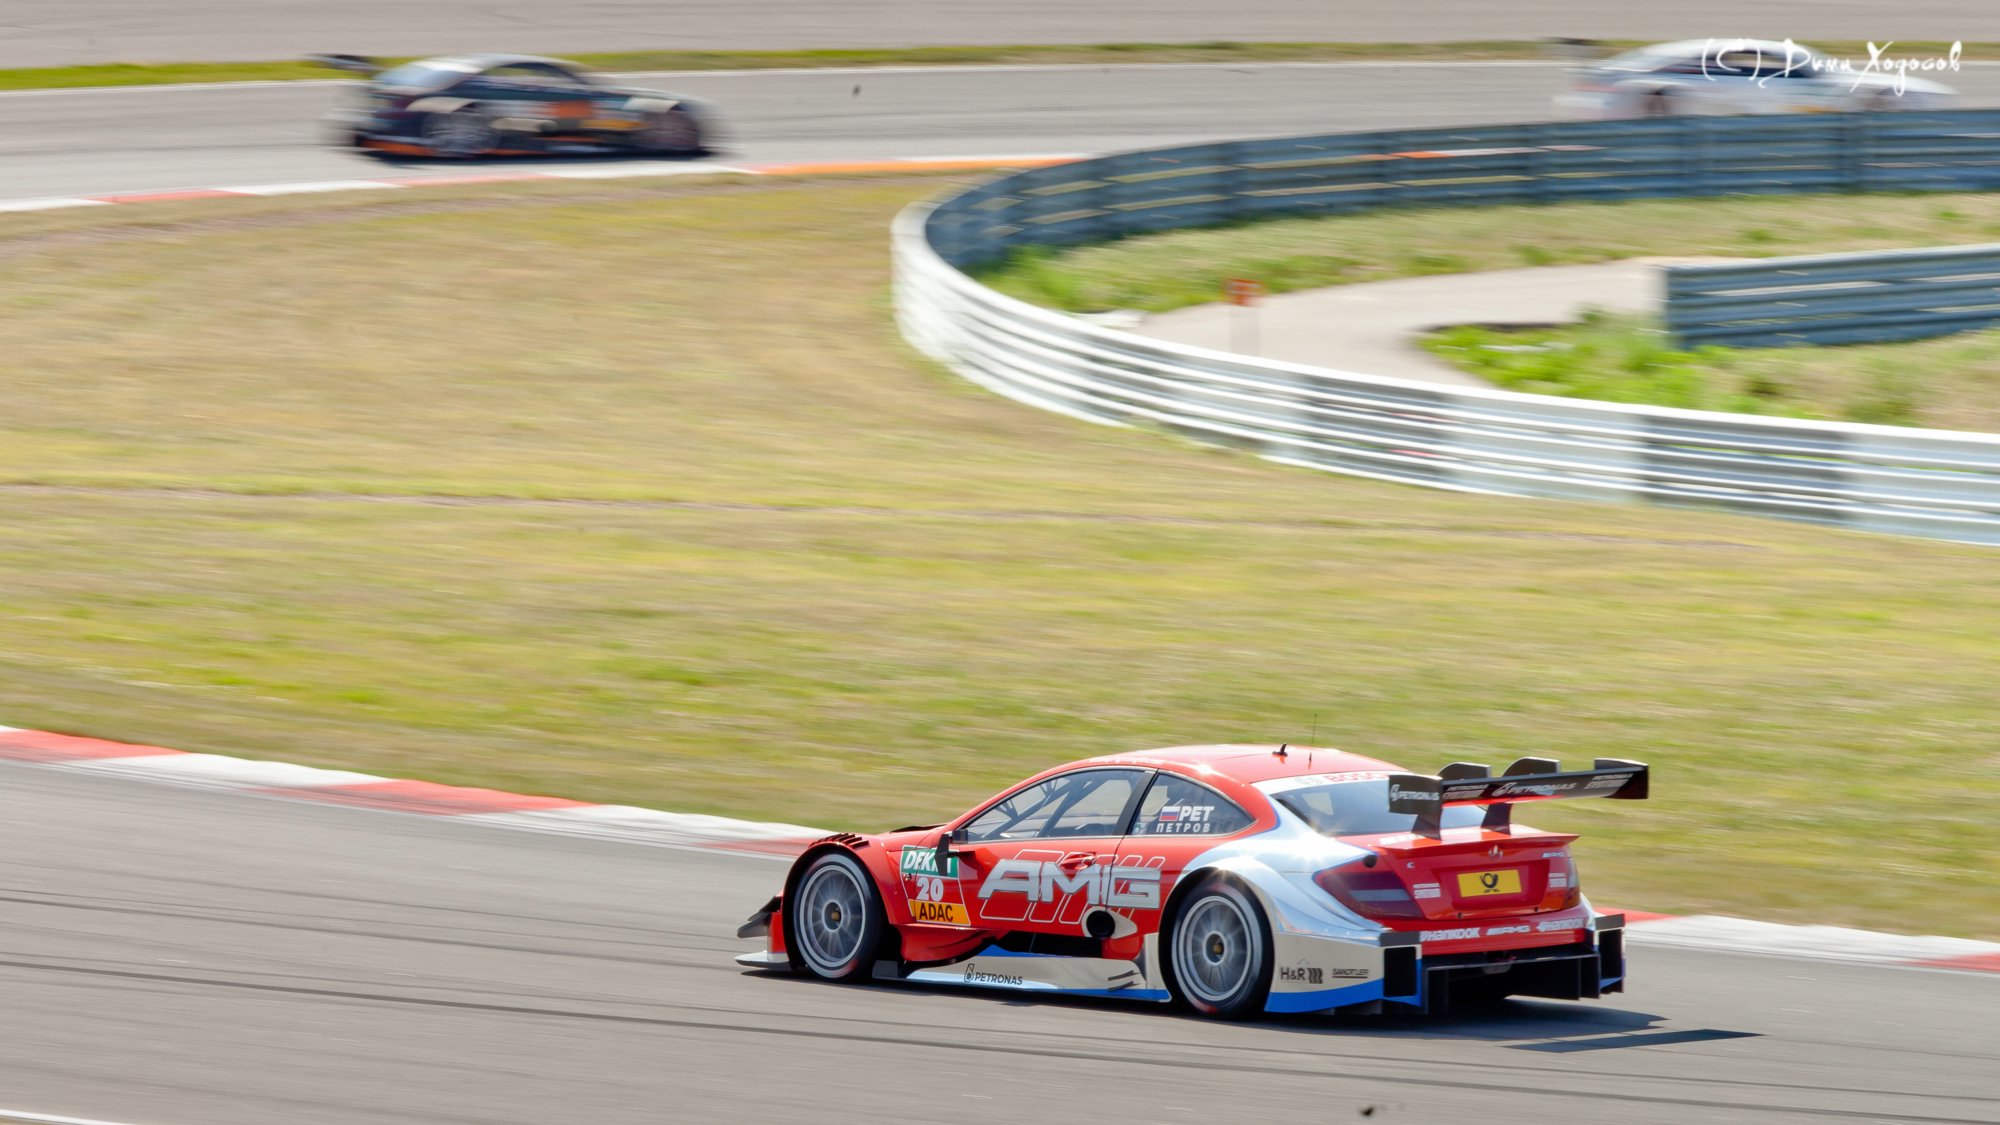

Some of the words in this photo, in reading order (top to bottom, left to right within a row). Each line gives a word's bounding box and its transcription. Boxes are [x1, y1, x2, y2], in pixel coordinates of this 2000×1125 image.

[1323, 771, 1388, 783] BOSC
[1155, 822, 1211, 833] ПЕТРОВ
[915, 877, 944, 902] 20
[977, 858, 1162, 910] AMG
[919, 902, 954, 922] ADAC
[975, 972, 1023, 986] PETRONAS
[1280, 966, 1306, 981] H&R
